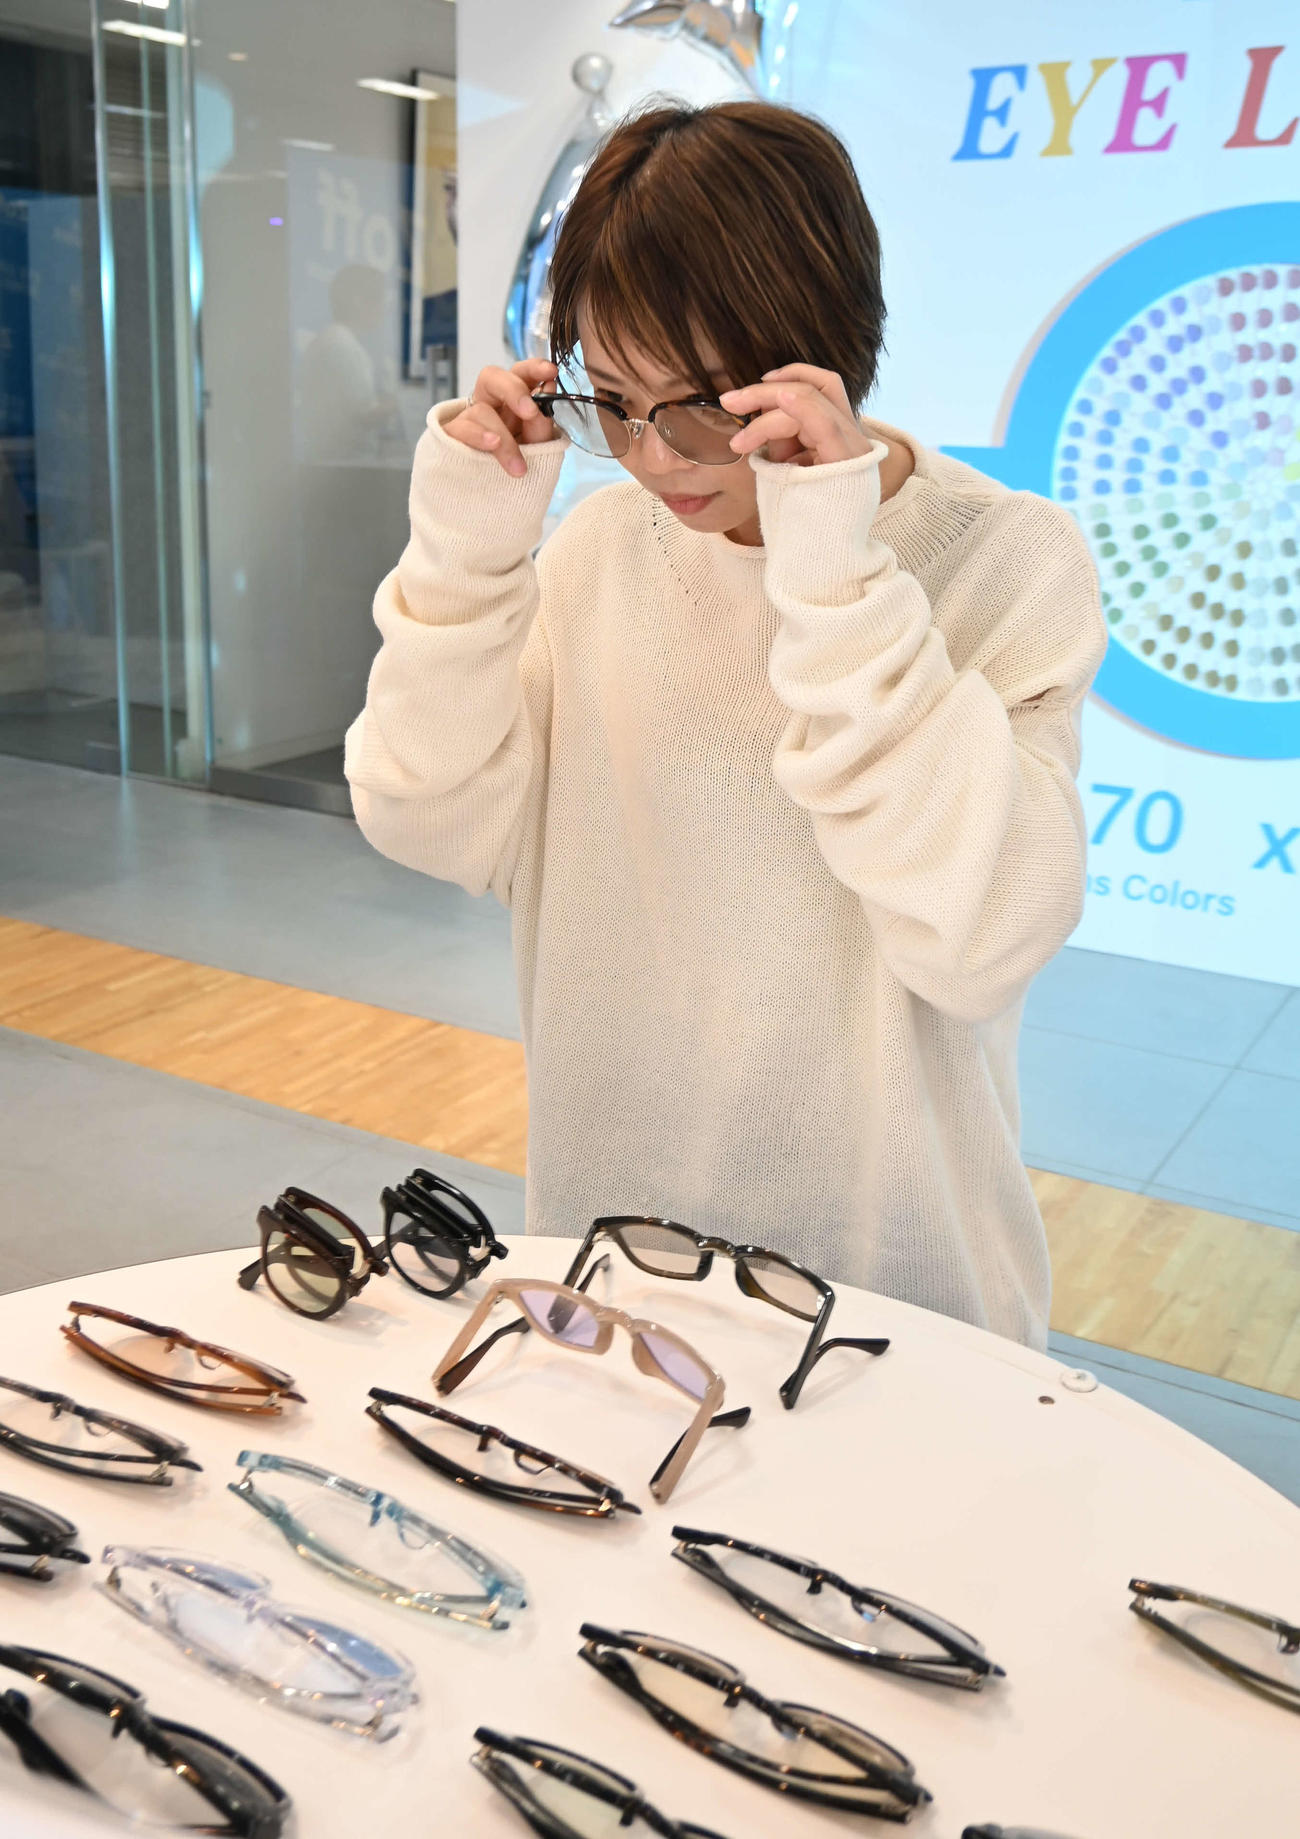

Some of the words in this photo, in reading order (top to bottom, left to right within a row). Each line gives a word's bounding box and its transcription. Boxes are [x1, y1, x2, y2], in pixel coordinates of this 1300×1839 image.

[950, 52, 1188, 162] EYE
[1090, 783, 1184, 854] 70
[1121, 873, 1236, 917] Colors
